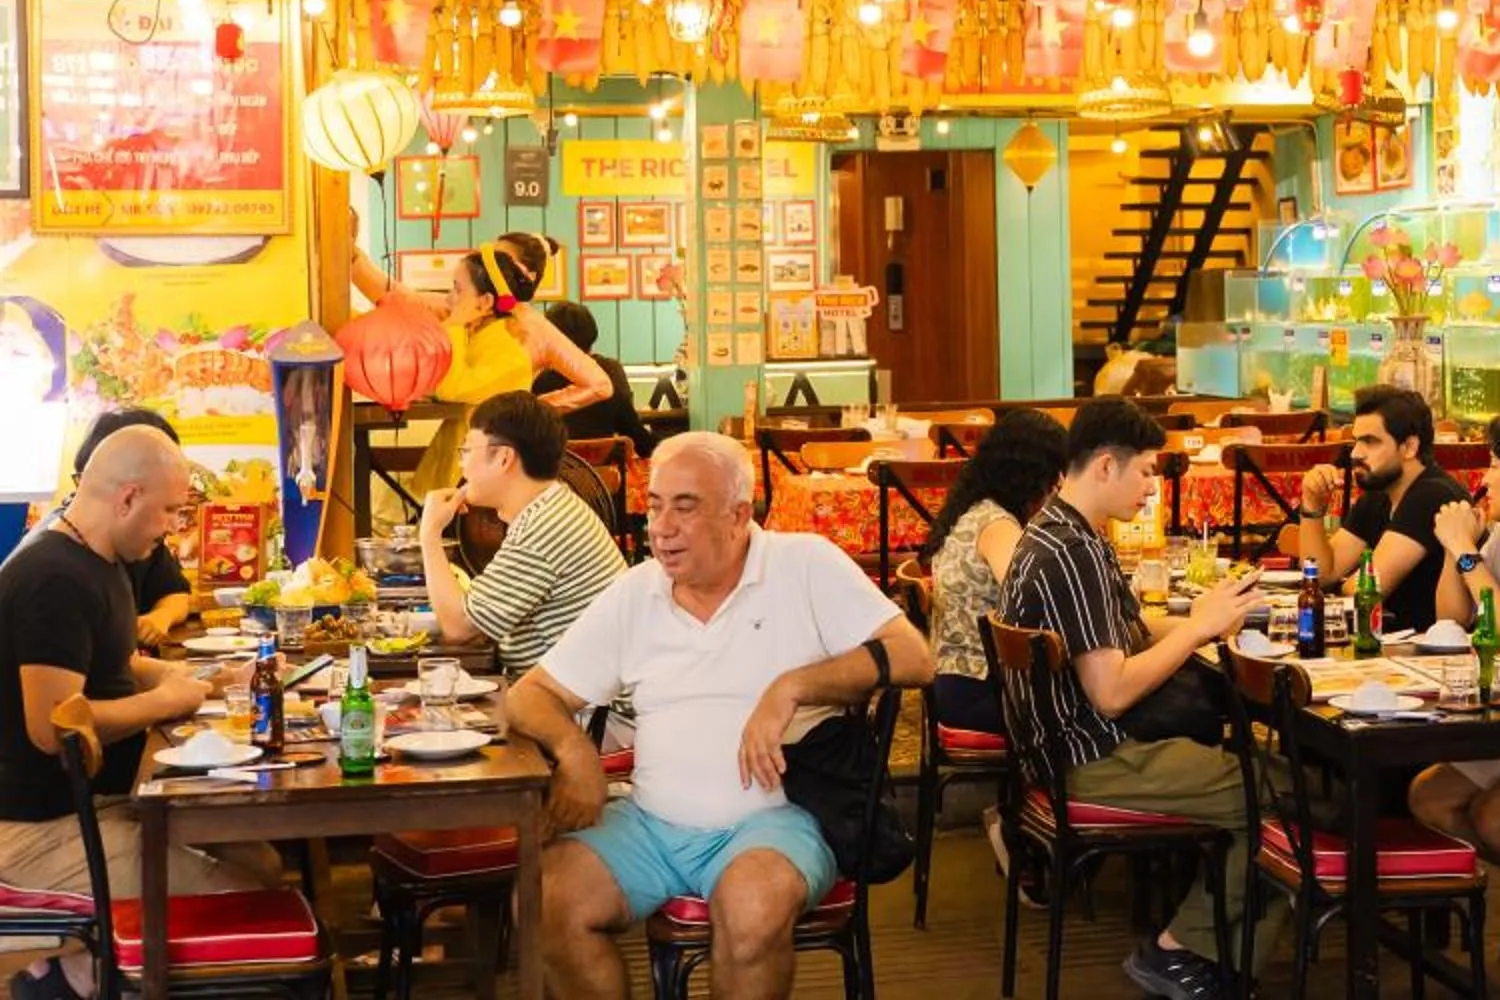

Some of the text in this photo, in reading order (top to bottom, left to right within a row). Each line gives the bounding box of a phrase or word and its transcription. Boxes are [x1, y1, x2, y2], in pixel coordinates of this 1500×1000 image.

[581, 158, 684, 178] THE RIC
[514, 181, 541, 197] 9.0
